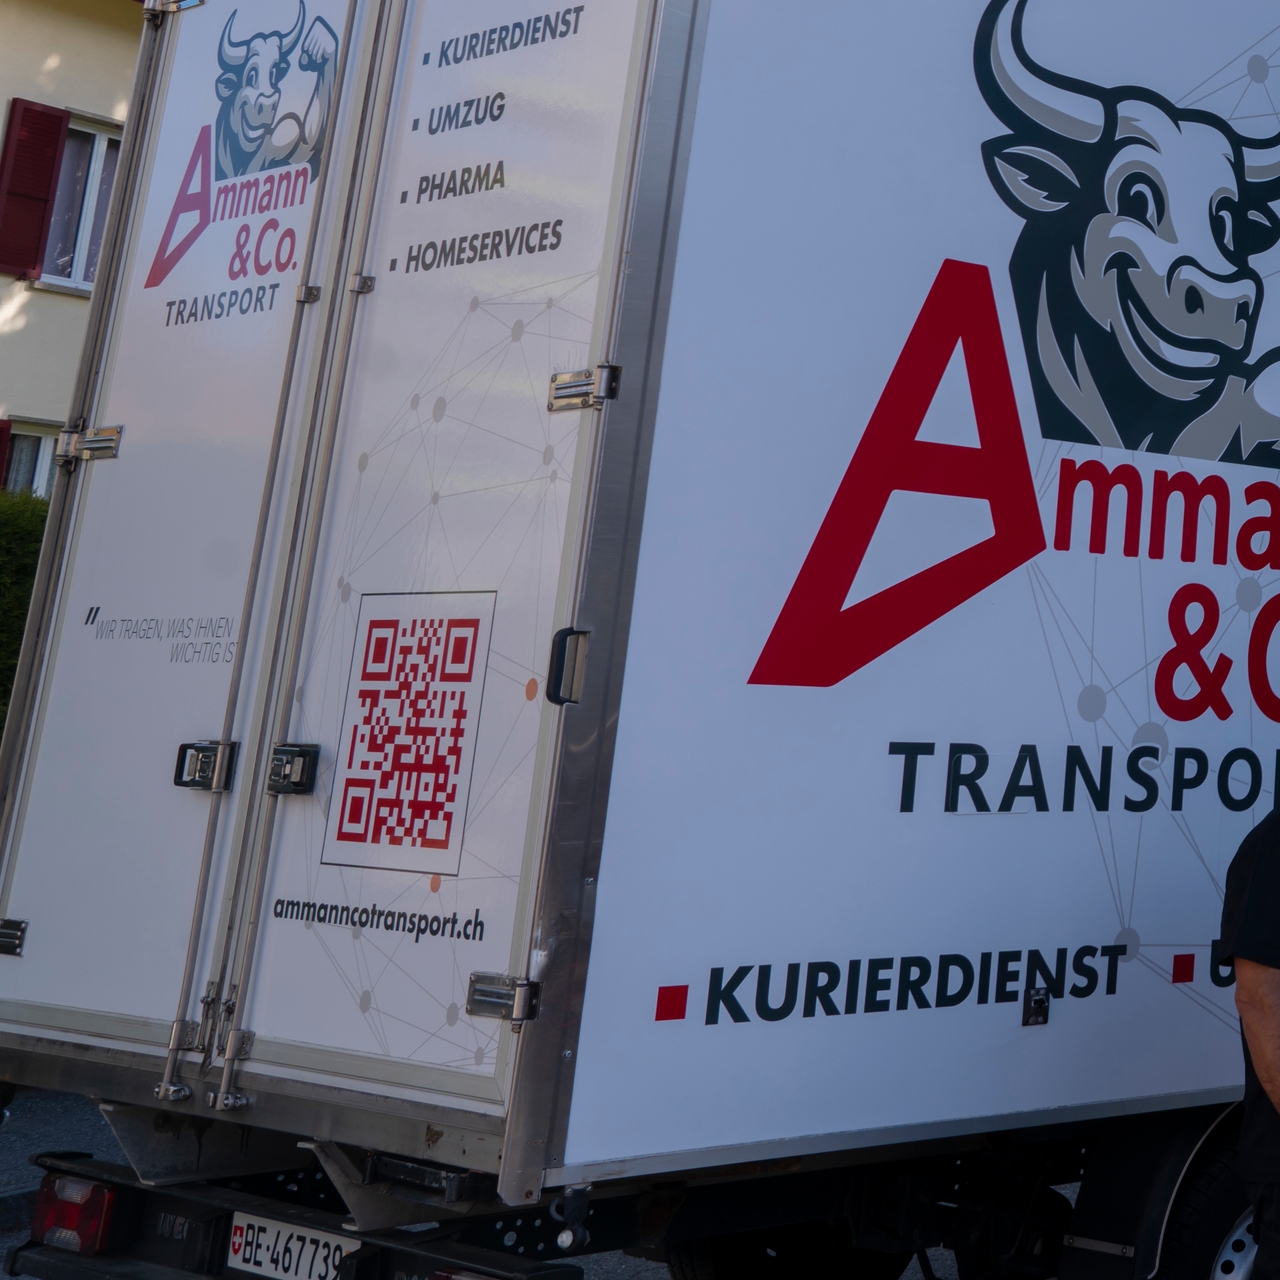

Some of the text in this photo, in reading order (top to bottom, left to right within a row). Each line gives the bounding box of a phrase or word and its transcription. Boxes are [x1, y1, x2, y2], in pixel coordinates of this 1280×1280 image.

[438, 5, 584, 70] KURIERDIENST
[427, 92, 505, 136] UMZUG
[416, 160, 505, 205] PHARMA
[143, 123, 309, 289] Ammann
[228, 218, 297, 281] &Co.
[404, 219, 563, 274] HOMESERVICES
[165, 283, 280, 328] TRANSPORT
[118, 618, 165, 642] TRAGEN,
[166, 617, 194, 639] WAS
[194, 617, 235, 638] IHNEN
[170, 641, 239, 663] WICHTIG IS
[273, 898, 485, 944] ammanncotransport.ch
[705, 944, 1127, 1026] KURIERDIENST
